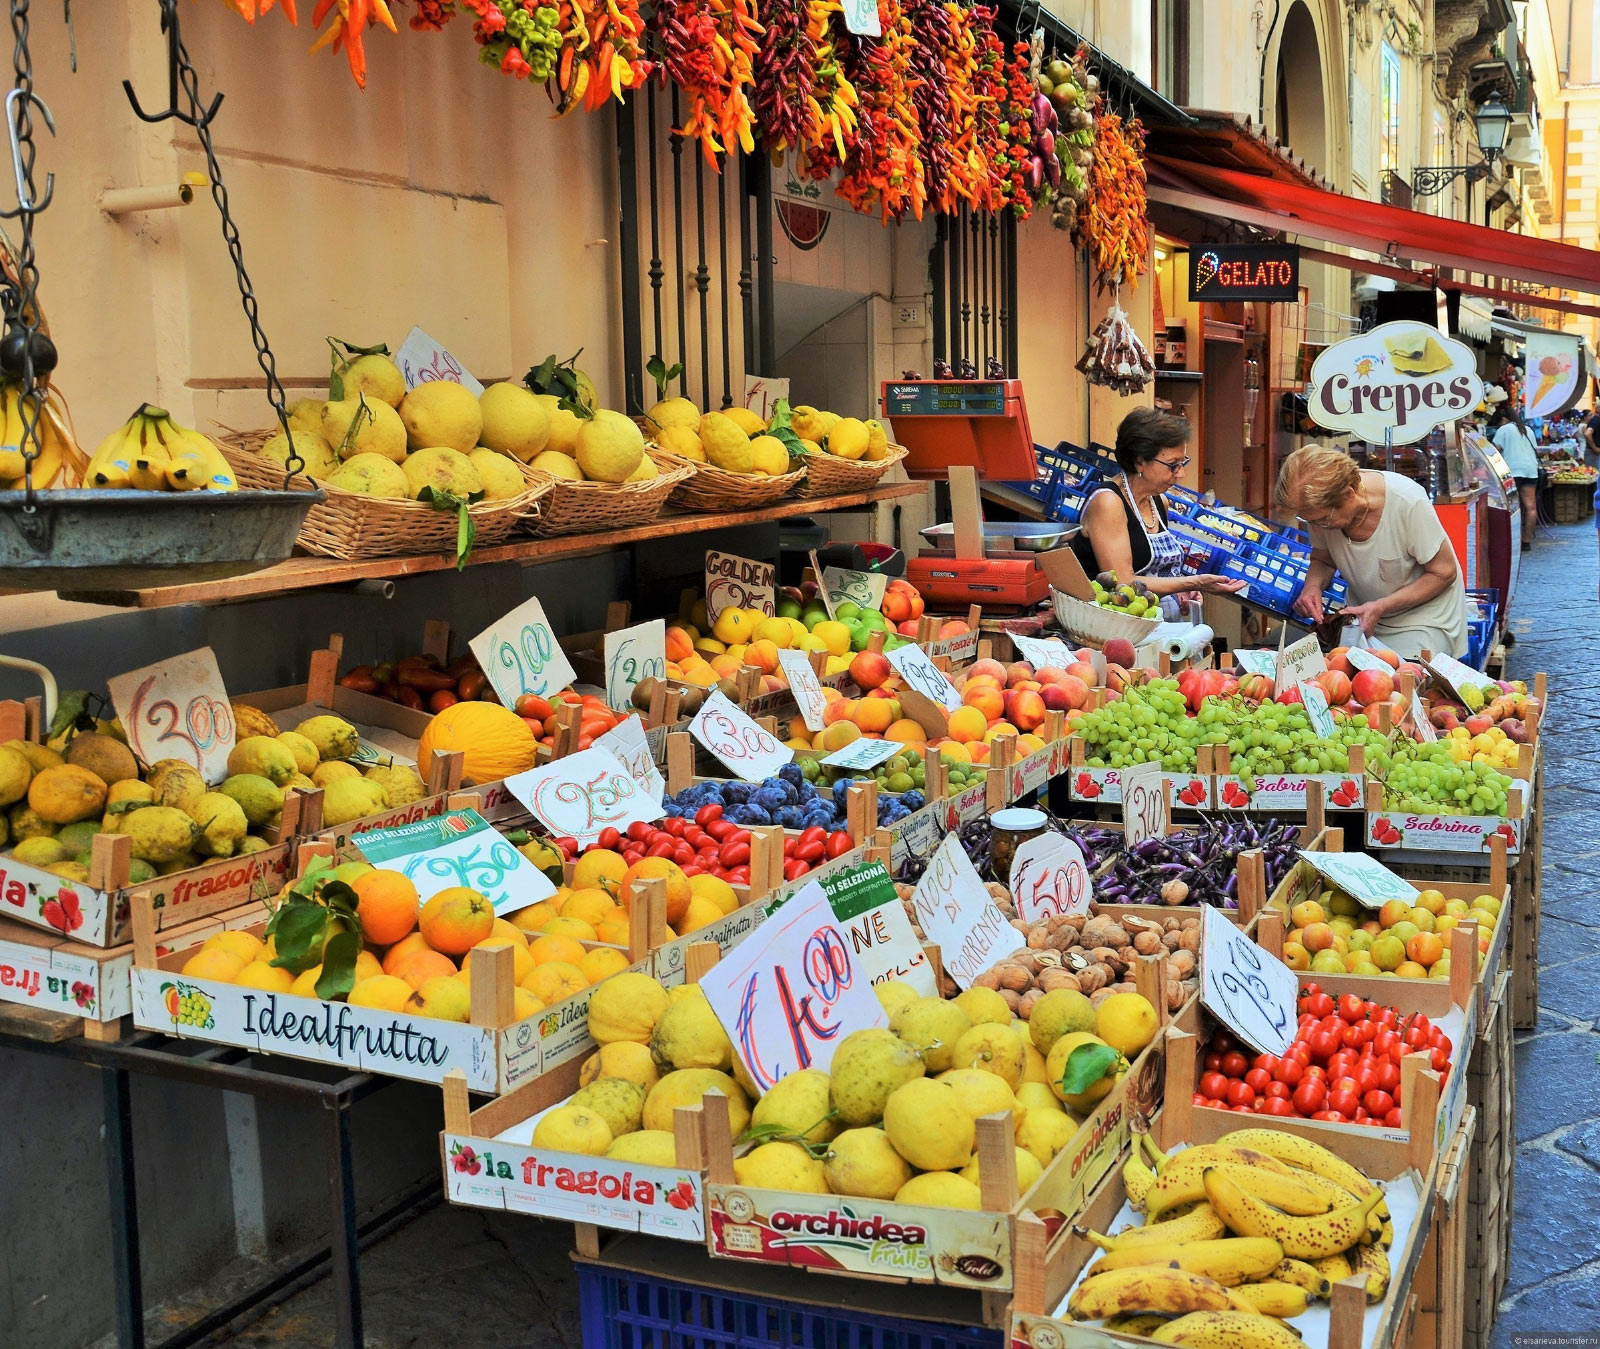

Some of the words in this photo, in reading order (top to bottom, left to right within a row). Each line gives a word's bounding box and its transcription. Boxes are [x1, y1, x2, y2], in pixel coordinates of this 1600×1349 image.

[1218, 260, 1293, 286] GELATO
[1320, 373, 1472, 427] Crepes
[706, 552, 775, 588] GOLDEN
[1024, 752, 1049, 775] Sabrina
[385, 821, 438, 838] SELEZIONATI
[899, 813, 931, 840] Idealfrutta
[1404, 816, 1483, 835] Sabrina
[173, 860, 268, 905] fragola
[837, 865, 887, 891] SELEZIONA
[915, 843, 959, 931] NOCI
[944, 893, 962, 924] DI
[950, 903, 1002, 984] SORRENTO
[243, 995, 450, 1065] Idealfrutta
[1070, 1102, 1123, 1179] orchidea
[483, 1151, 515, 1181] la
[520, 1156, 655, 1206] fragola
[770, 1207, 927, 1245] orchidea
[959, 1257, 995, 1276] Gold
